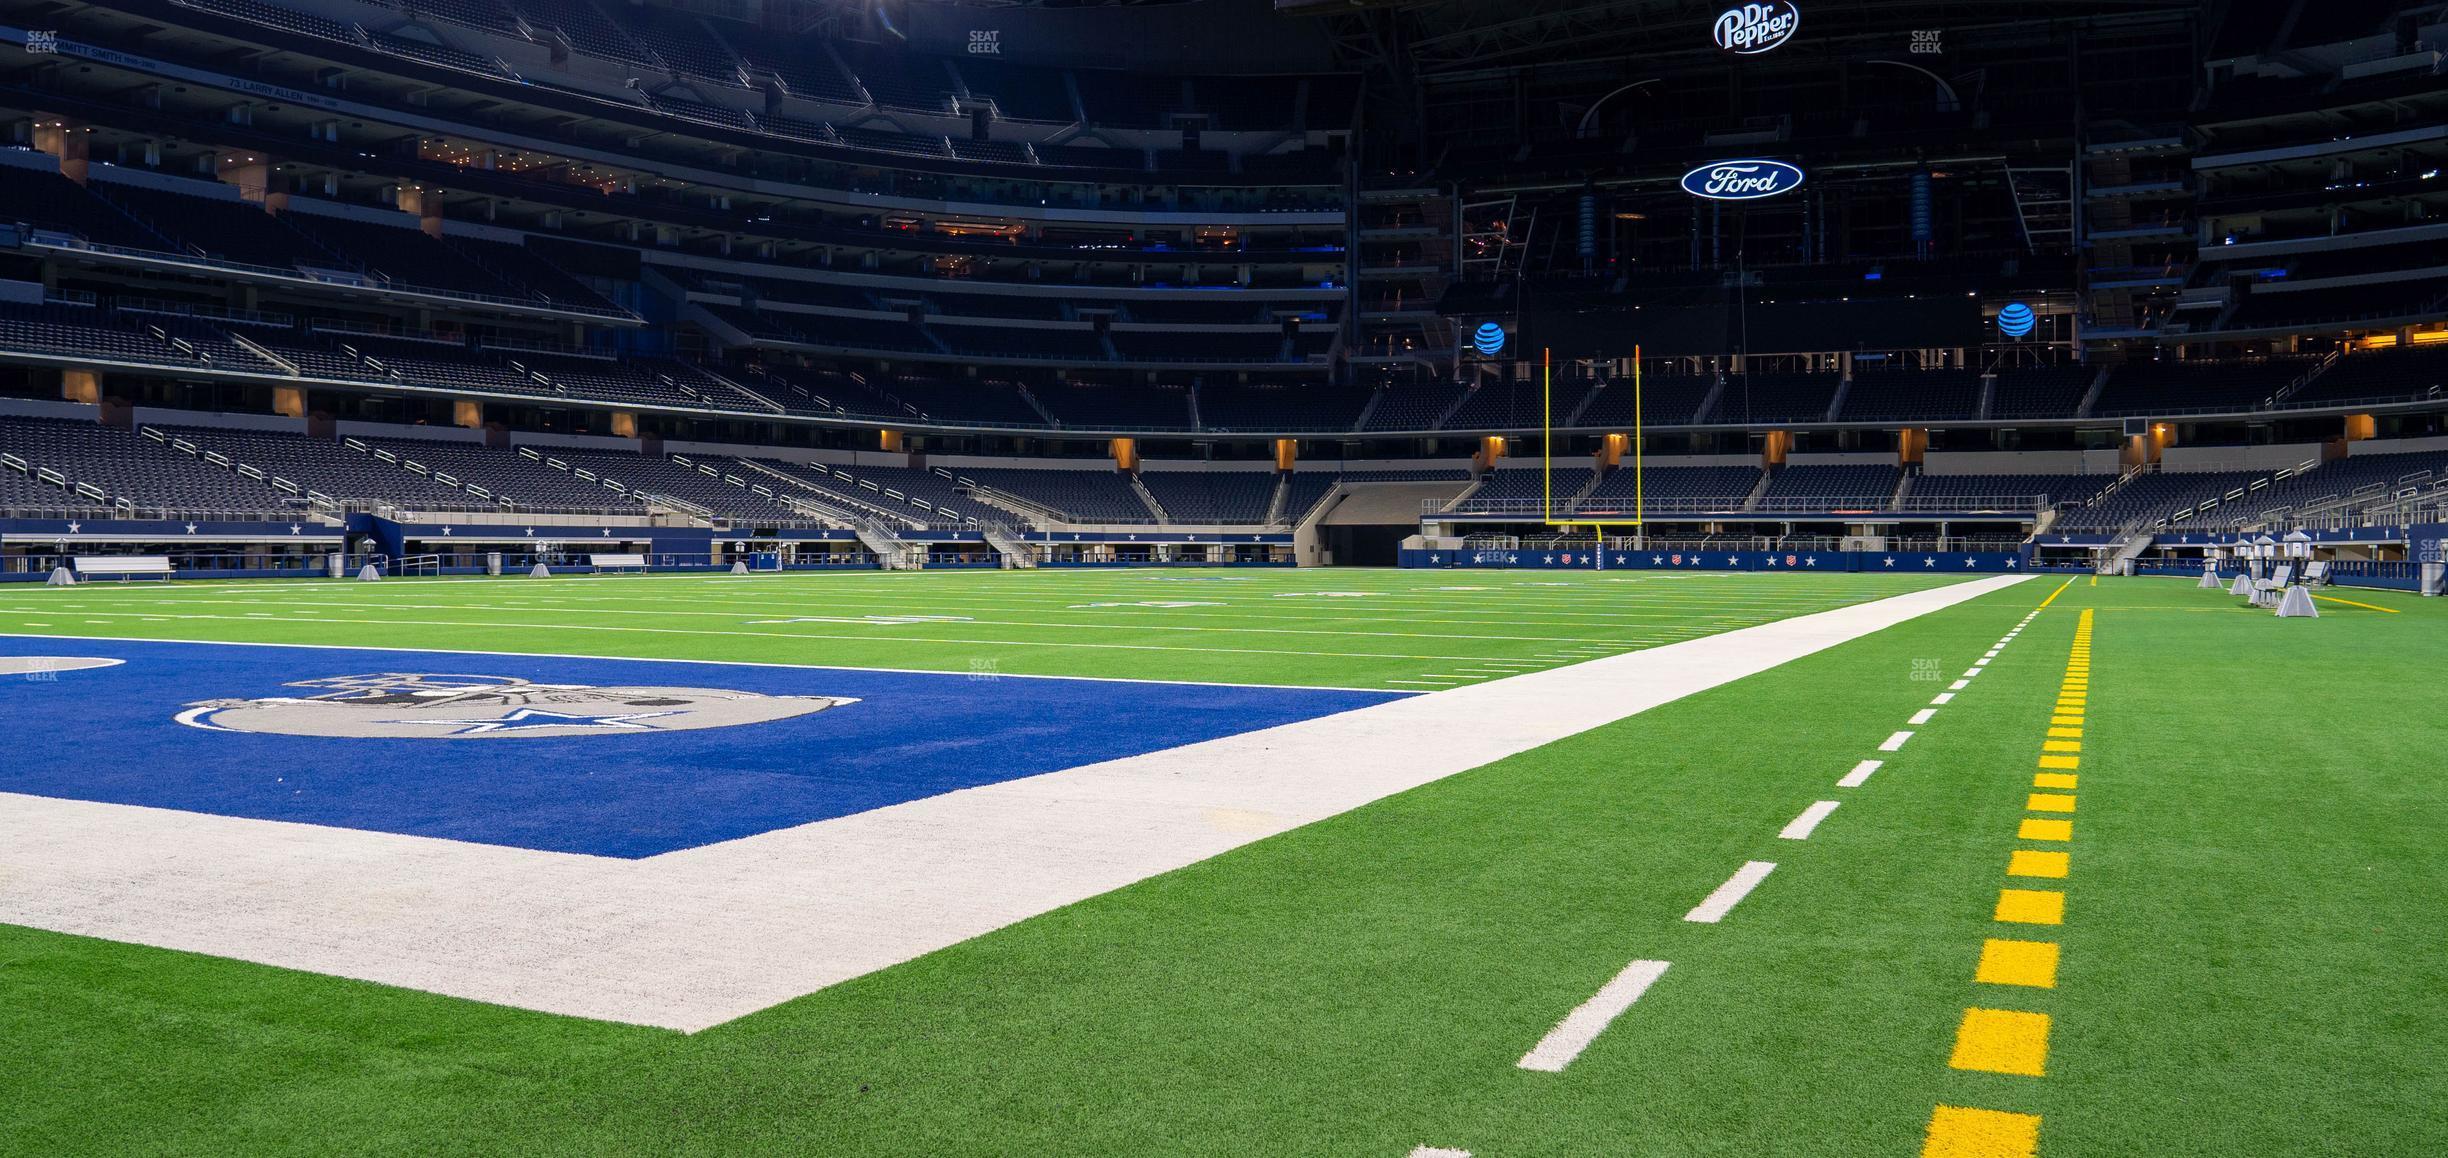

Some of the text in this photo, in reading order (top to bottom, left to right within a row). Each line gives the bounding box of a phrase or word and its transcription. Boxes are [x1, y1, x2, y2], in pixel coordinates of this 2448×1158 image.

[1743, 3, 1774, 28] Dr
[92, 48, 122, 63] SMITH
[229, 79, 240, 88] 73
[244, 82, 273, 96] LARRY
[275, 88, 303, 101] ALLEN
[1705, 166, 1778, 194] Ford
